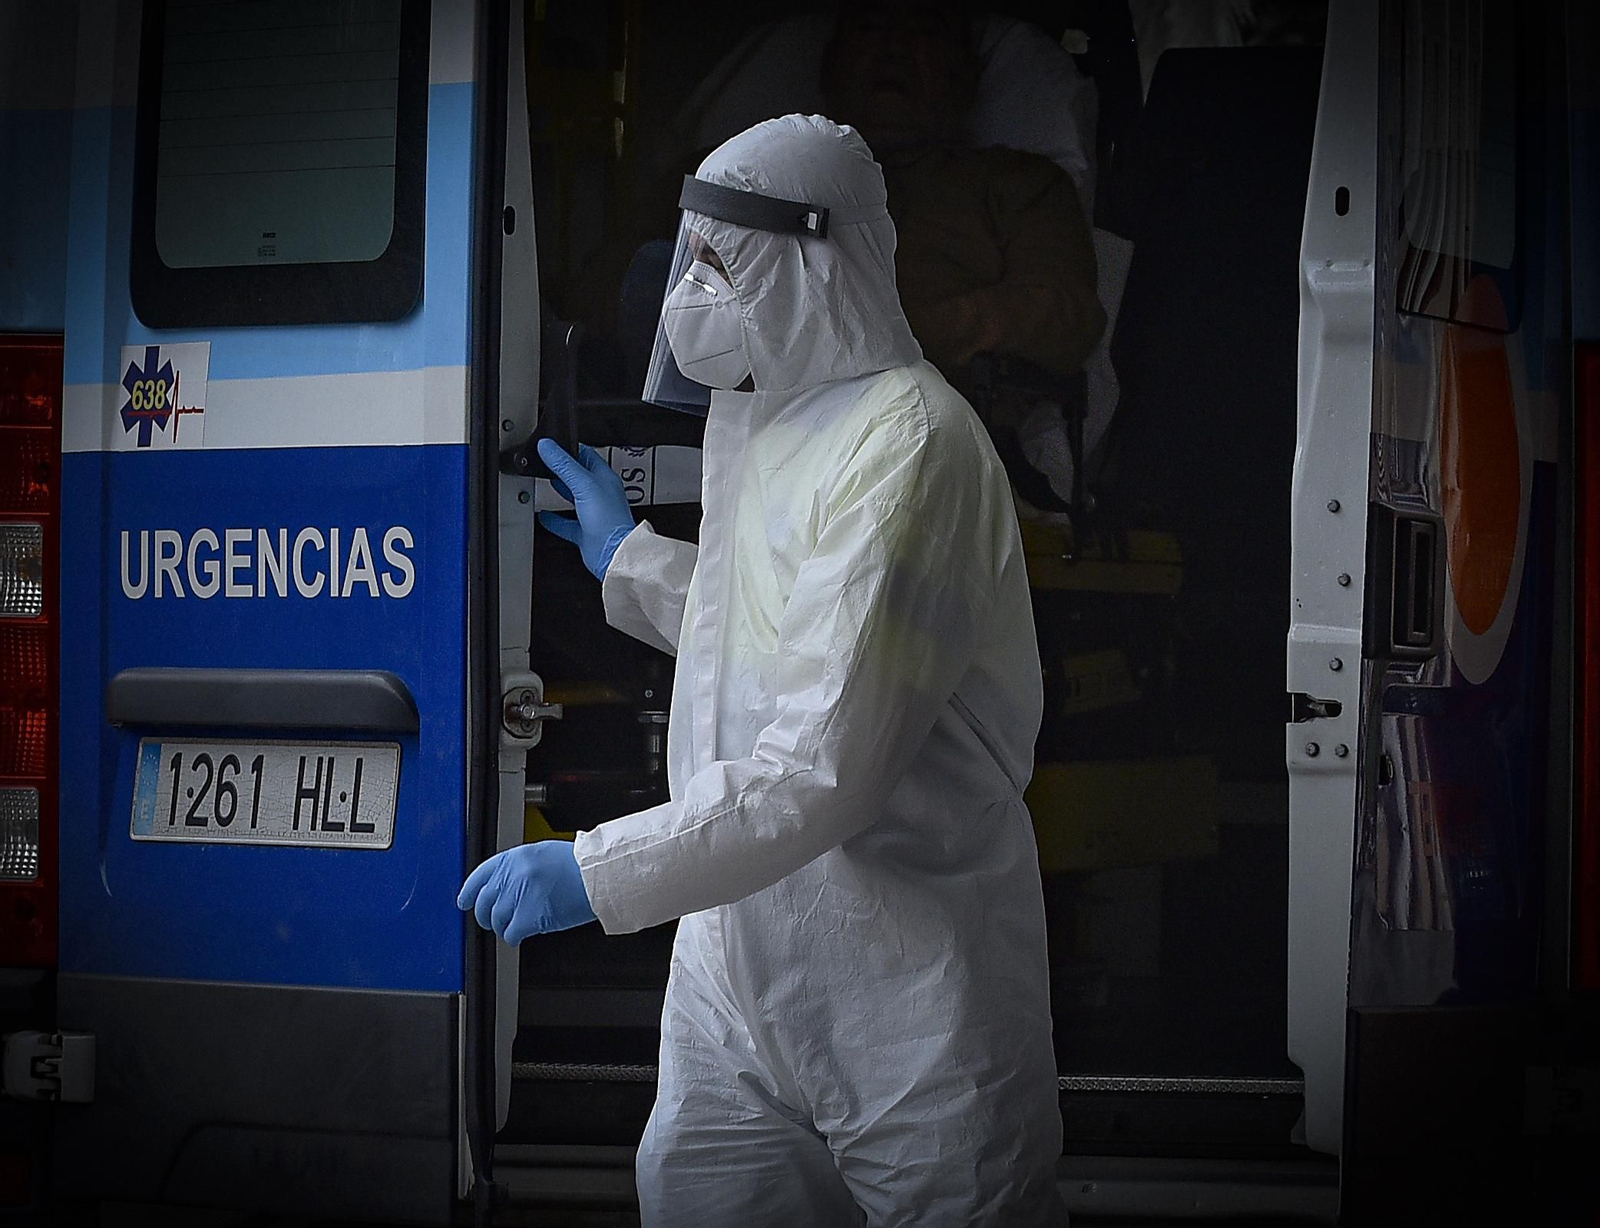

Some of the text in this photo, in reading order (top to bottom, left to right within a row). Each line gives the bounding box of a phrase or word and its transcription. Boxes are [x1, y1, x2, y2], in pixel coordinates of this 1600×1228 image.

[131, 379, 167, 410] 638
[120, 526, 415, 599] URGENCIAS
[168, 751, 377, 834] 1261 HLL
